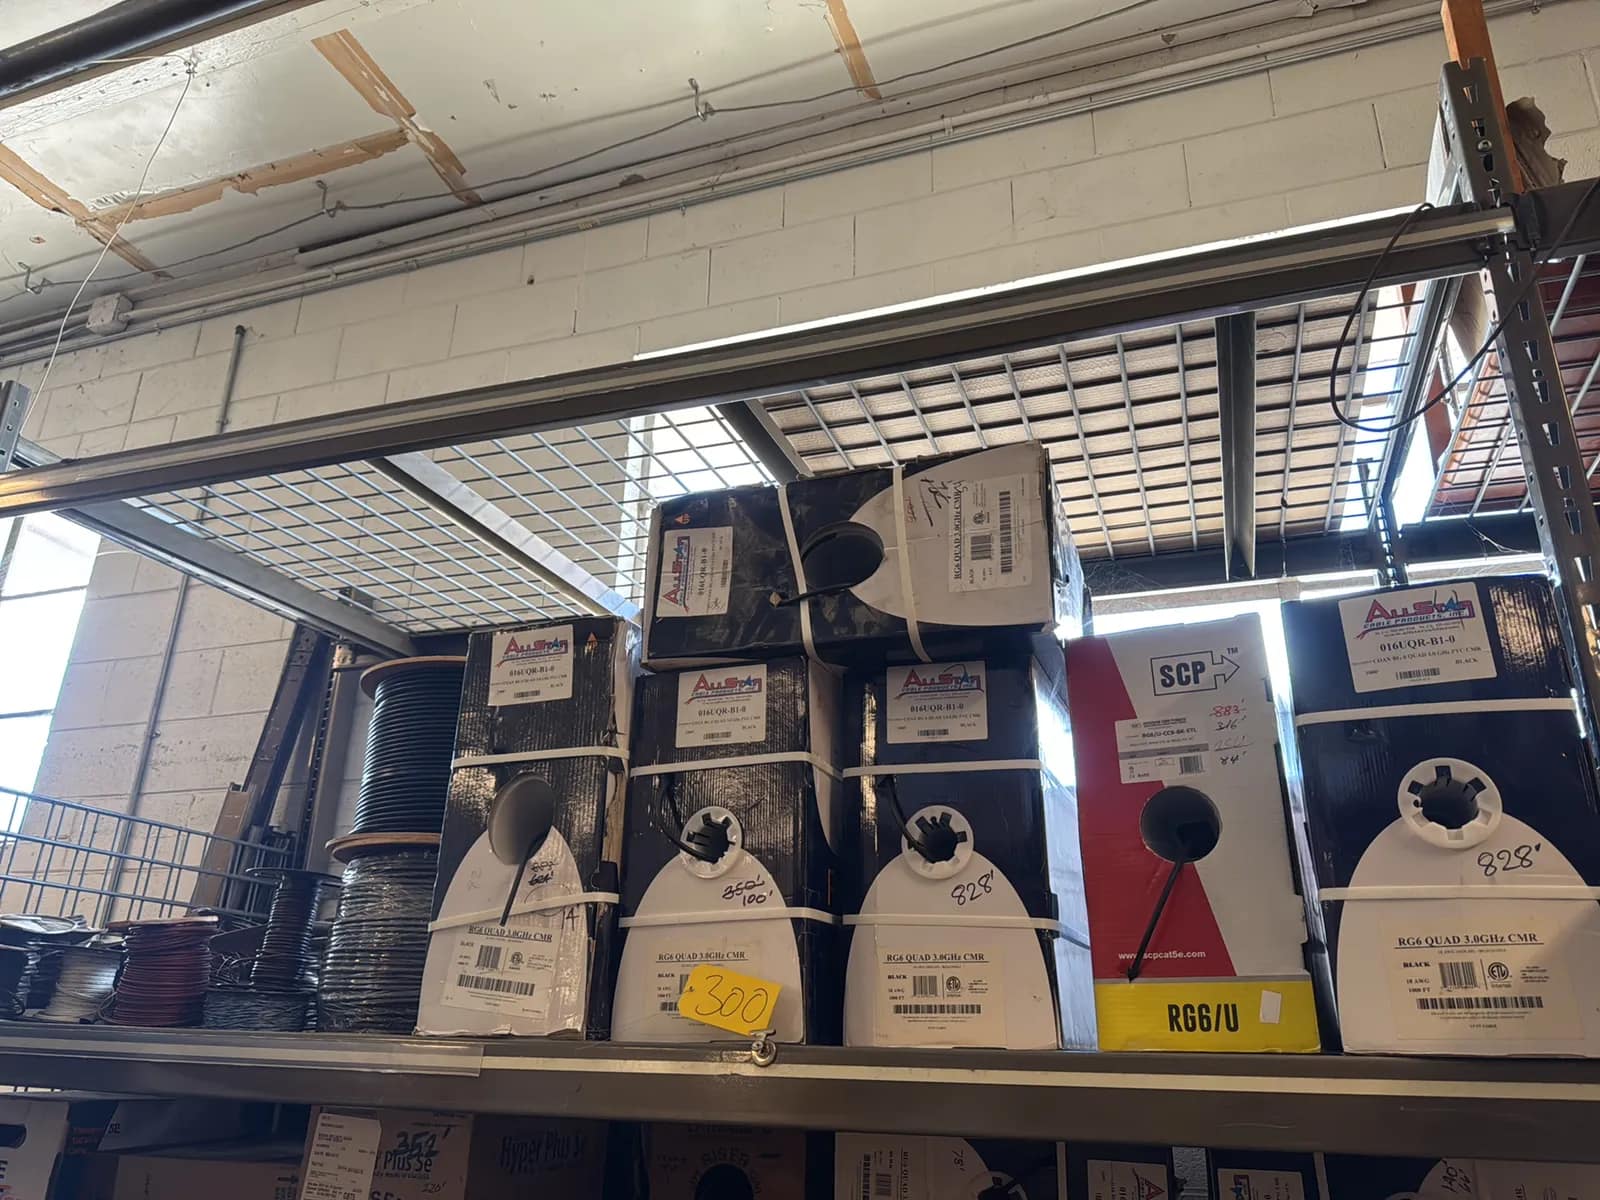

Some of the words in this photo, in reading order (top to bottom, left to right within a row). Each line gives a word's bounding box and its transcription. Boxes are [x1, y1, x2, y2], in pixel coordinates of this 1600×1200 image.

[953, 538, 962, 562] QUAD
[1379, 635, 1456, 653] 016UQR-B1-0
[1159, 661, 1206, 688] SCP
[1477, 843, 1541, 877] 828'
[951, 870, 994, 906] 828'
[742, 889, 773, 907] 100'
[484, 927, 506, 937] QUAD
[534, 932, 553, 942] CMR
[1398, 936, 1423, 947] RG6
[1425, 935, 1461, 948] QUAD
[1464, 934, 1506, 945] 3.0GHz
[1508, 932, 1538, 943] CMR
[658, 953, 674, 961] RG6
[675, 952, 698, 962] QUAD
[699, 951, 725, 960] 3.0GHz
[726, 951, 746, 960] CMR
[886, 953, 904, 962] RG6
[906, 953, 931, 963] QUAD
[932, 953, 962, 961] 3.0GHz
[963, 952, 985, 961] CMR
[1118, 950, 1206, 960] wwwscpcat5e.com
[695, 974, 769, 1024] 300
[1167, 1003, 1239, 1033] RG6/U
